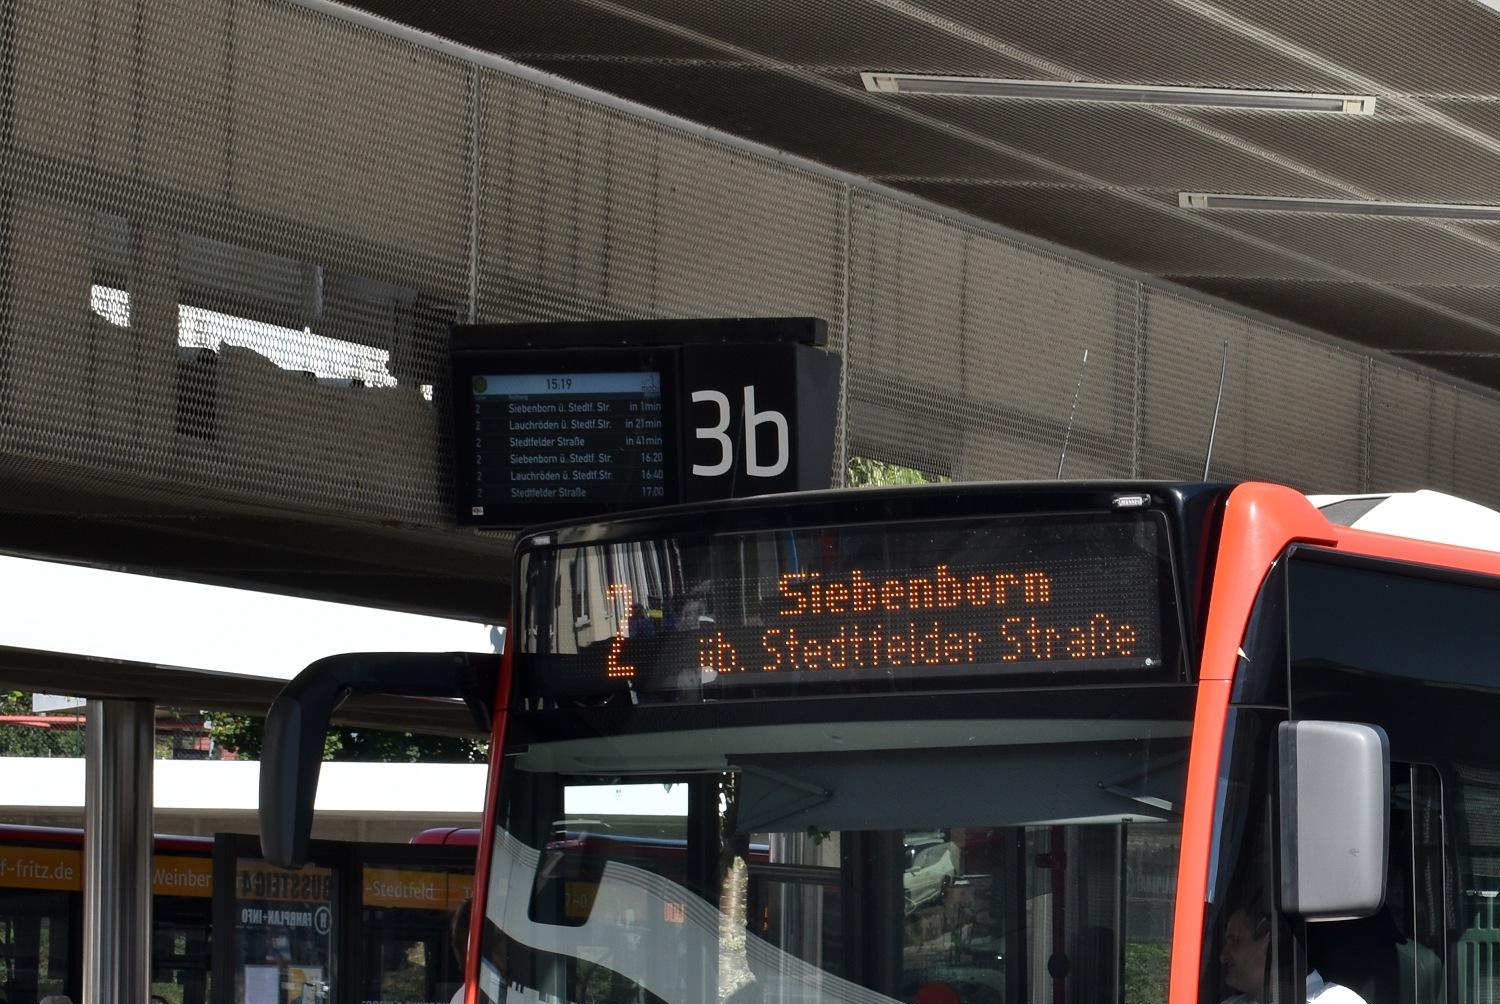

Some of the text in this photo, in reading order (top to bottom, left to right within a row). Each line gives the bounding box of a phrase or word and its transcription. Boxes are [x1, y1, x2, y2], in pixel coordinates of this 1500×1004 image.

[475, 404, 481, 414] 2
[508, 402, 557, 414] Siebenborn
[597, 402, 612, 413] Str.
[629, 402, 638, 412] in
[475, 421, 481, 431] 2
[509, 420, 559, 431] Lauchröden
[625, 420, 634, 429] in
[691, 385, 789, 477] 3b
[476, 438, 482, 448] 2
[509, 437, 556, 447] Stedtfelder
[557, 436, 585, 447] Straße
[625, 436, 634, 446] in
[476, 455, 482, 465] 2
[510, 454, 557, 465] Siebenborn
[598, 453, 614, 463] Str.
[477, 472, 482, 481] 2
[510, 470, 561, 481] Lauchröden
[477, 489, 483, 498] 2
[511, 488, 557, 498] Stedtfelder
[558, 487, 587, 498] Straße
[778, 562, 1052, 617] Siebenborn
[605, 582, 636, 679] 2
[698, 611, 1137, 675] üb. Stedtfelder Straße
